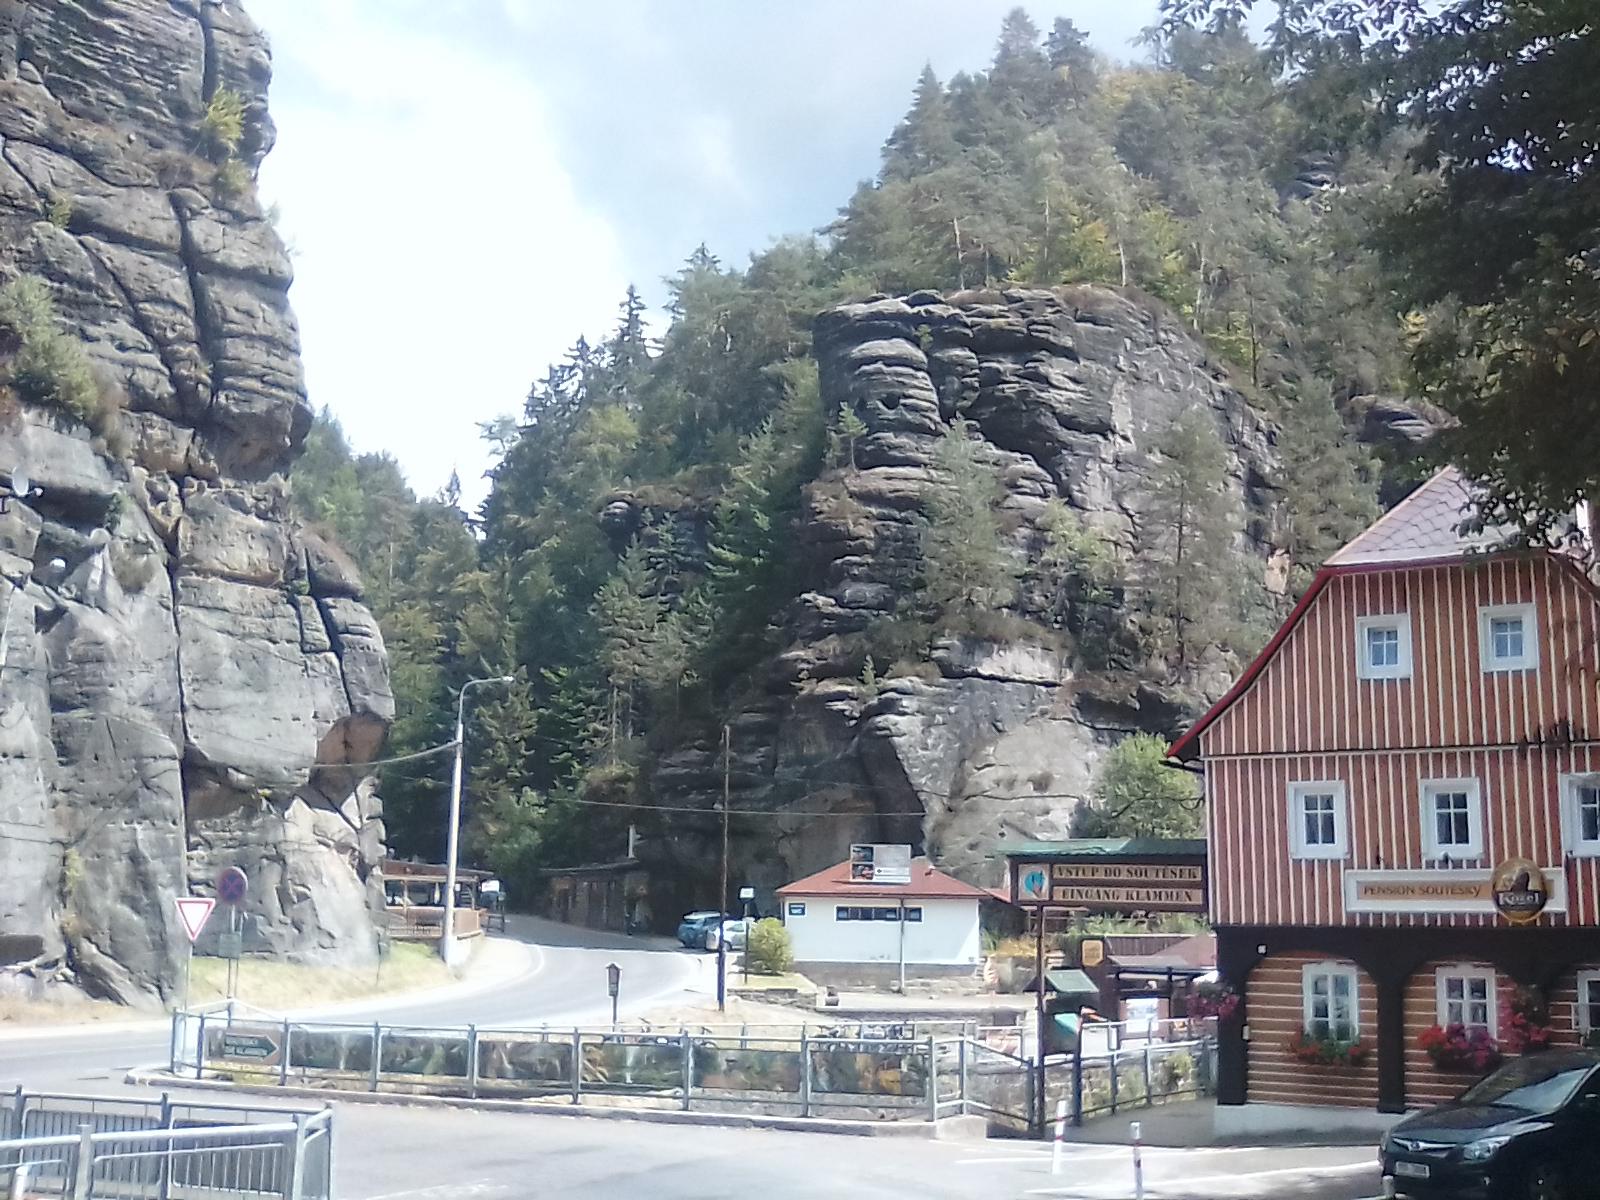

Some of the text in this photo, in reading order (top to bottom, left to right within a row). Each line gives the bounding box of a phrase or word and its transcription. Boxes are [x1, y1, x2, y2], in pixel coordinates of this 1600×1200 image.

[1057, 866, 1100, 878] VSTUP
[1103, 866, 1121, 878] DO
[1062, 888, 1194, 901] EINGANG KLAMMEN
[1363, 885, 1416, 896] PENSION
